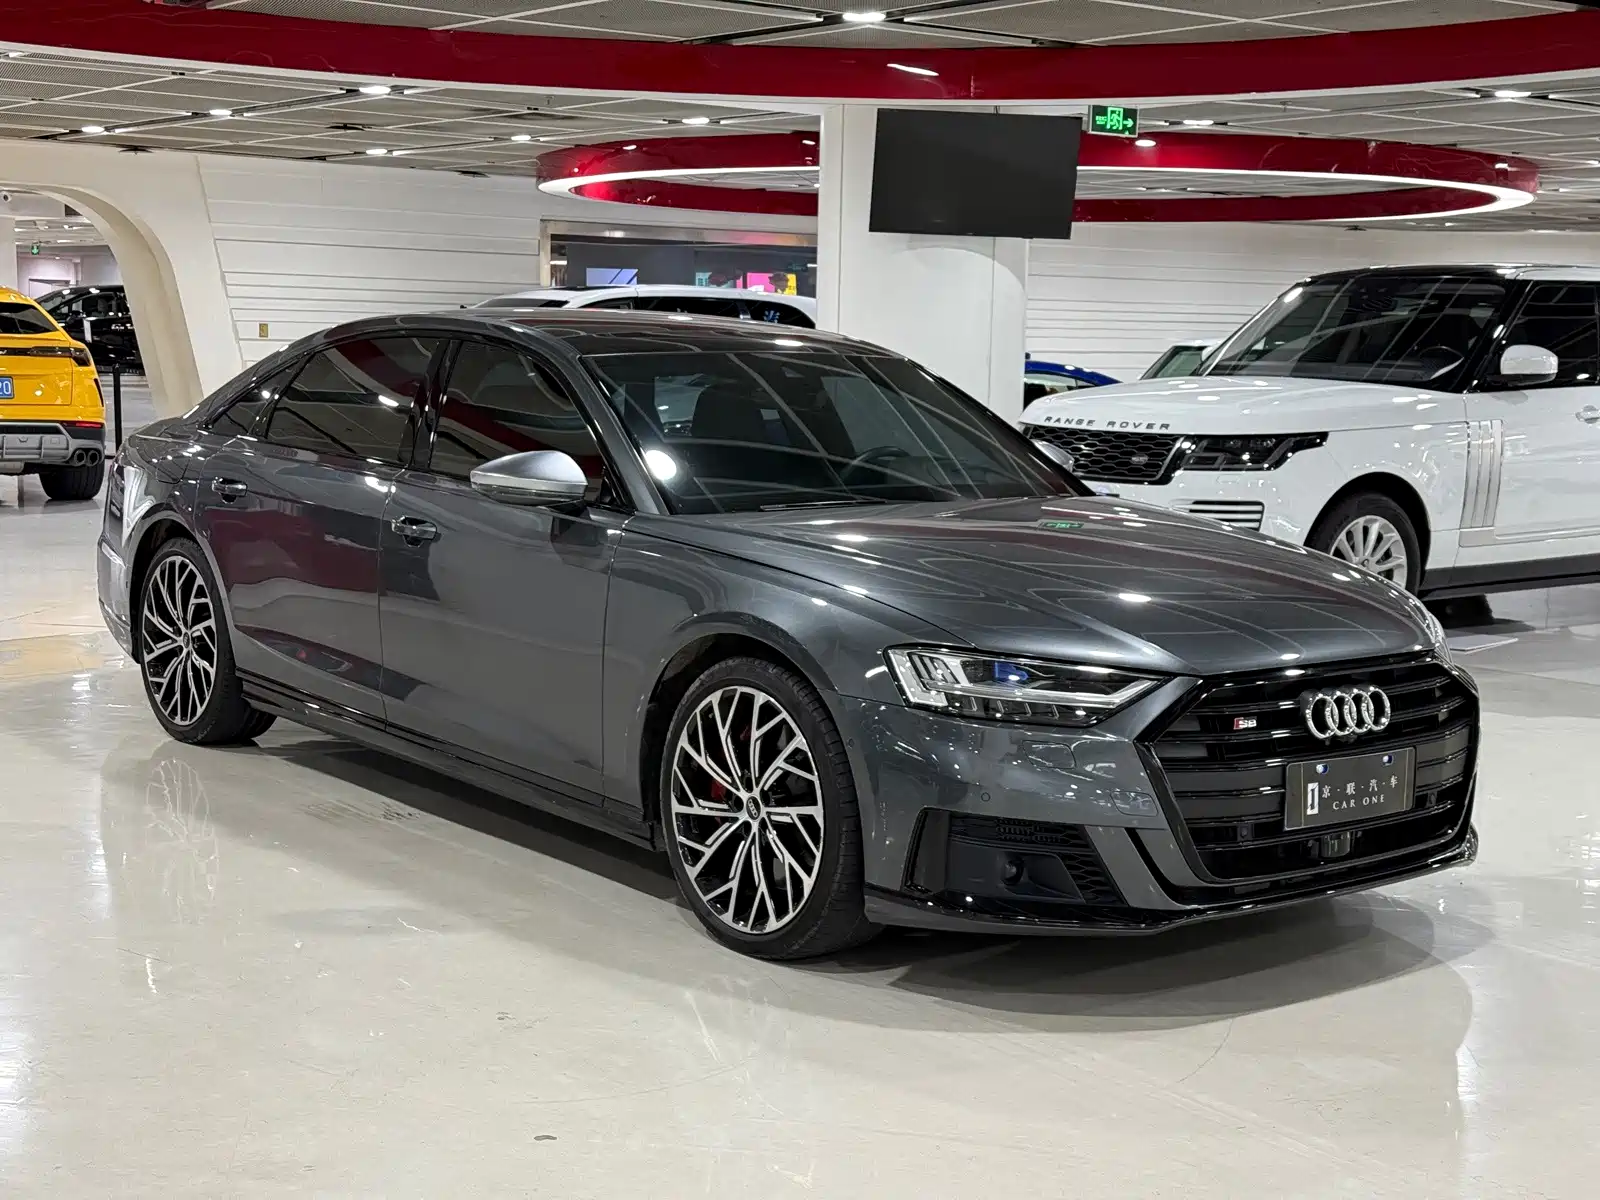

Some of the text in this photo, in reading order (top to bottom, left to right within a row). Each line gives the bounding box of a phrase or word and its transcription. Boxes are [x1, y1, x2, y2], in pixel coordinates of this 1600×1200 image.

[1044, 416, 1170, 430] RANGE ROVER
[1332, 794, 1385, 810] CAR ONE
